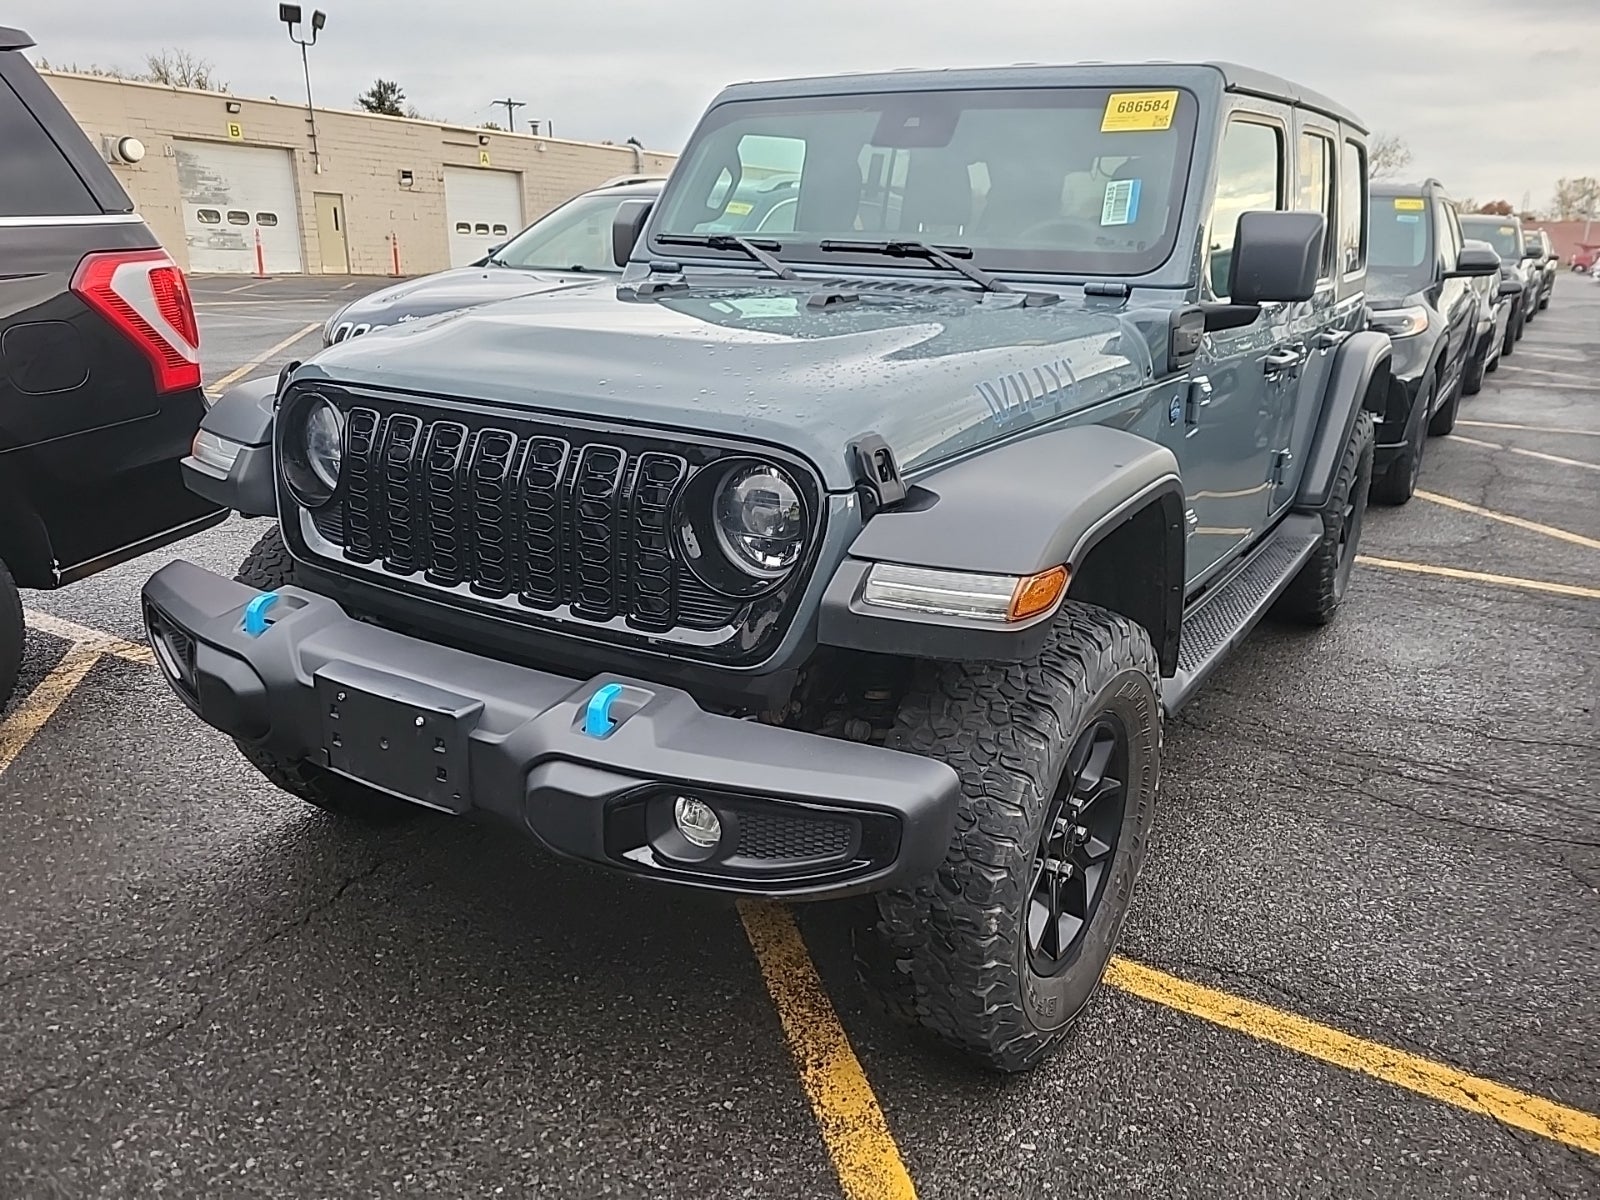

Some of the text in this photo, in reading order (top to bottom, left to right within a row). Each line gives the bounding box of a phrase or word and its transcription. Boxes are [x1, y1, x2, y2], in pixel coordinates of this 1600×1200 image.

[1117, 99, 1170, 113] 686584
[229, 124, 240, 137] B
[481, 153, 489, 164] A
